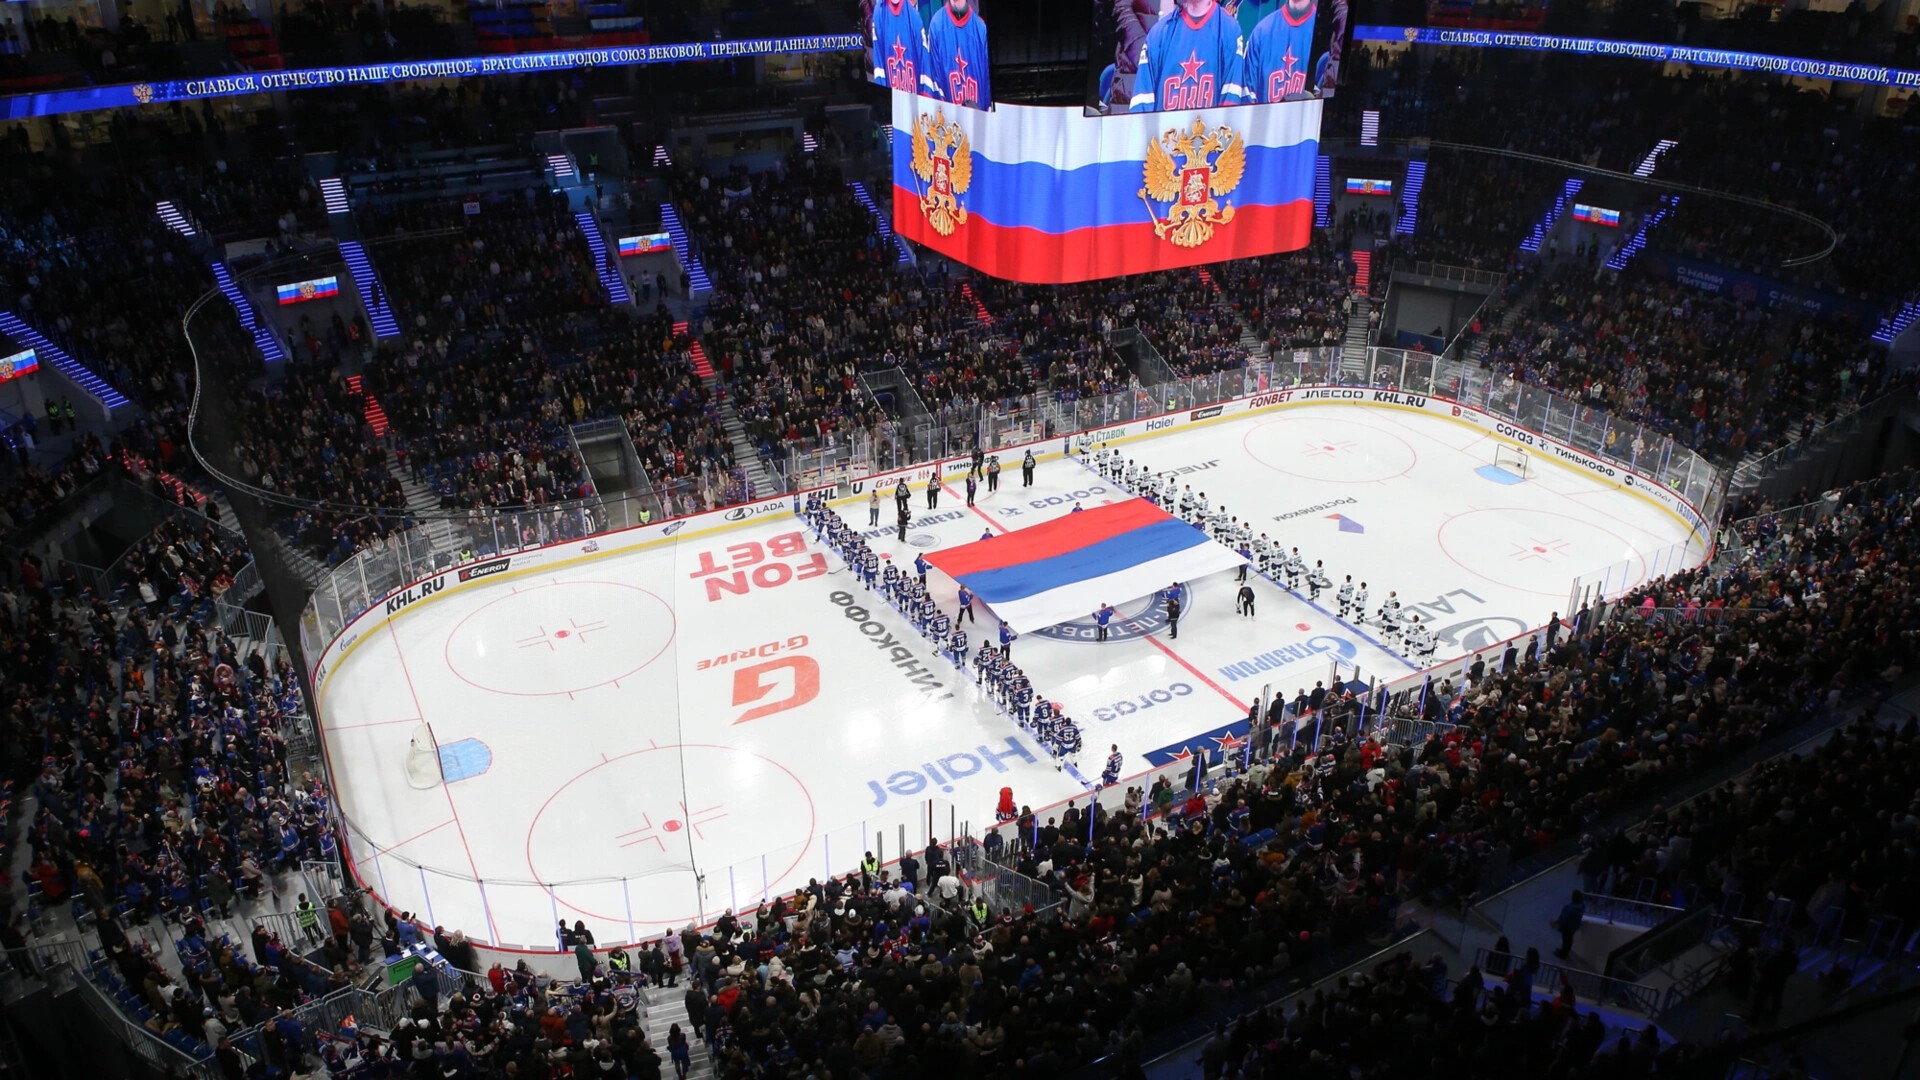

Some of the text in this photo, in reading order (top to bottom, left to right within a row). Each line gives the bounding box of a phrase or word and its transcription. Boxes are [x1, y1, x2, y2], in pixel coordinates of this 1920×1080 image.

[186, 77, 260, 96] СЛАВЬСЯ,
[261, 70, 345, 89] ОТЕЧЕСТВО
[347, 66, 390, 82] НАШЕ
[392, 60, 477, 78] СВОБОДНОЕ,
[482, 54, 548, 72] БРАТСКИХ
[550, 51, 609, 67] НАРОДОВ
[611, 48, 647, 62] СОЮЗ
[649, 43, 707, 60] ВЕКОВОЙ,
[711, 40, 773, 56] ПРЕДКАМИ
[774, 37, 820, 53] ДАННАЯ
[1440, 31, 1492, 46] СЛАВЬСЯ,
[1495, 35, 1559, 49] ОТЕЧЕСТВО
[1561, 40, 1595, 51] НАШЕ
[1597, 42, 1667, 59] СВОБОДНОЕ,
[1672, 47, 1731, 64] БРАТСКИХ
[1733, 53, 1788, 71] НАРОДОВ
[1790, 60, 1825, 75] СОЮЗ
[1827, 64, 1890, 84] ВЕКОВОЙ,
[1249, 391, 1293, 409] FONBET
[1373, 391, 1426, 408] KHL.RU
[1146, 417, 1175, 431] Haier
[1555, 446, 1615, 477] ТИНЬКОФФ
[755, 501, 785, 514] LADA
[690, 531, 808, 579] BET
[705, 552, 829, 602] FON
[888, 571, 896, 579] 14
[386, 576, 445, 615] KHL.RU
[957, 637, 965, 646] 17
[1218, 641, 1331, 682] ГАЗПРОМ
[1023, 693, 1029, 703] 3
[1042, 708, 1048, 718] 9
[1063, 731, 1075, 742] 52
[866, 736, 1038, 808] Haier
